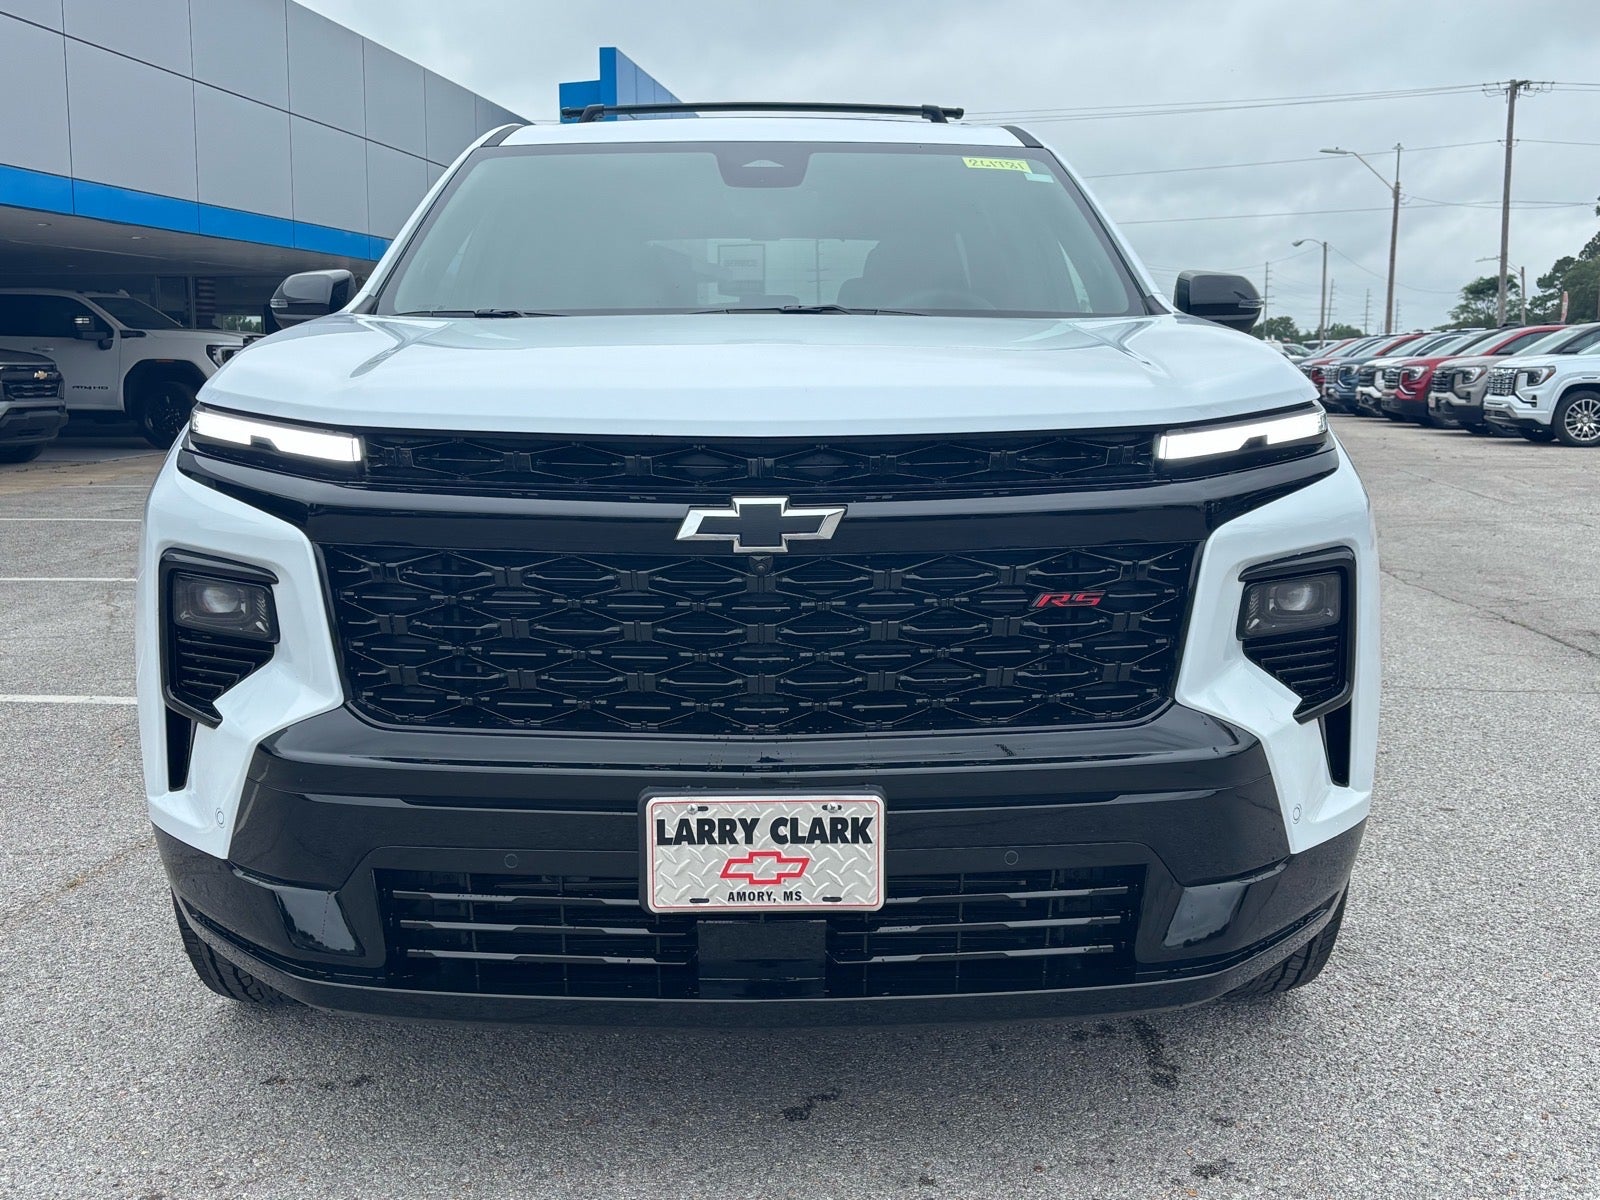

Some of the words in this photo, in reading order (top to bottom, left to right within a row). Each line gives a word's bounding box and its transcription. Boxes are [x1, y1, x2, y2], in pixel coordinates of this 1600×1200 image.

[1032, 590, 1106, 608] RS
[656, 818, 760, 846] LARRY
[769, 816, 873, 844] CLARK
[727, 891, 776, 903] AMORY,
[783, 891, 803, 902] MS
